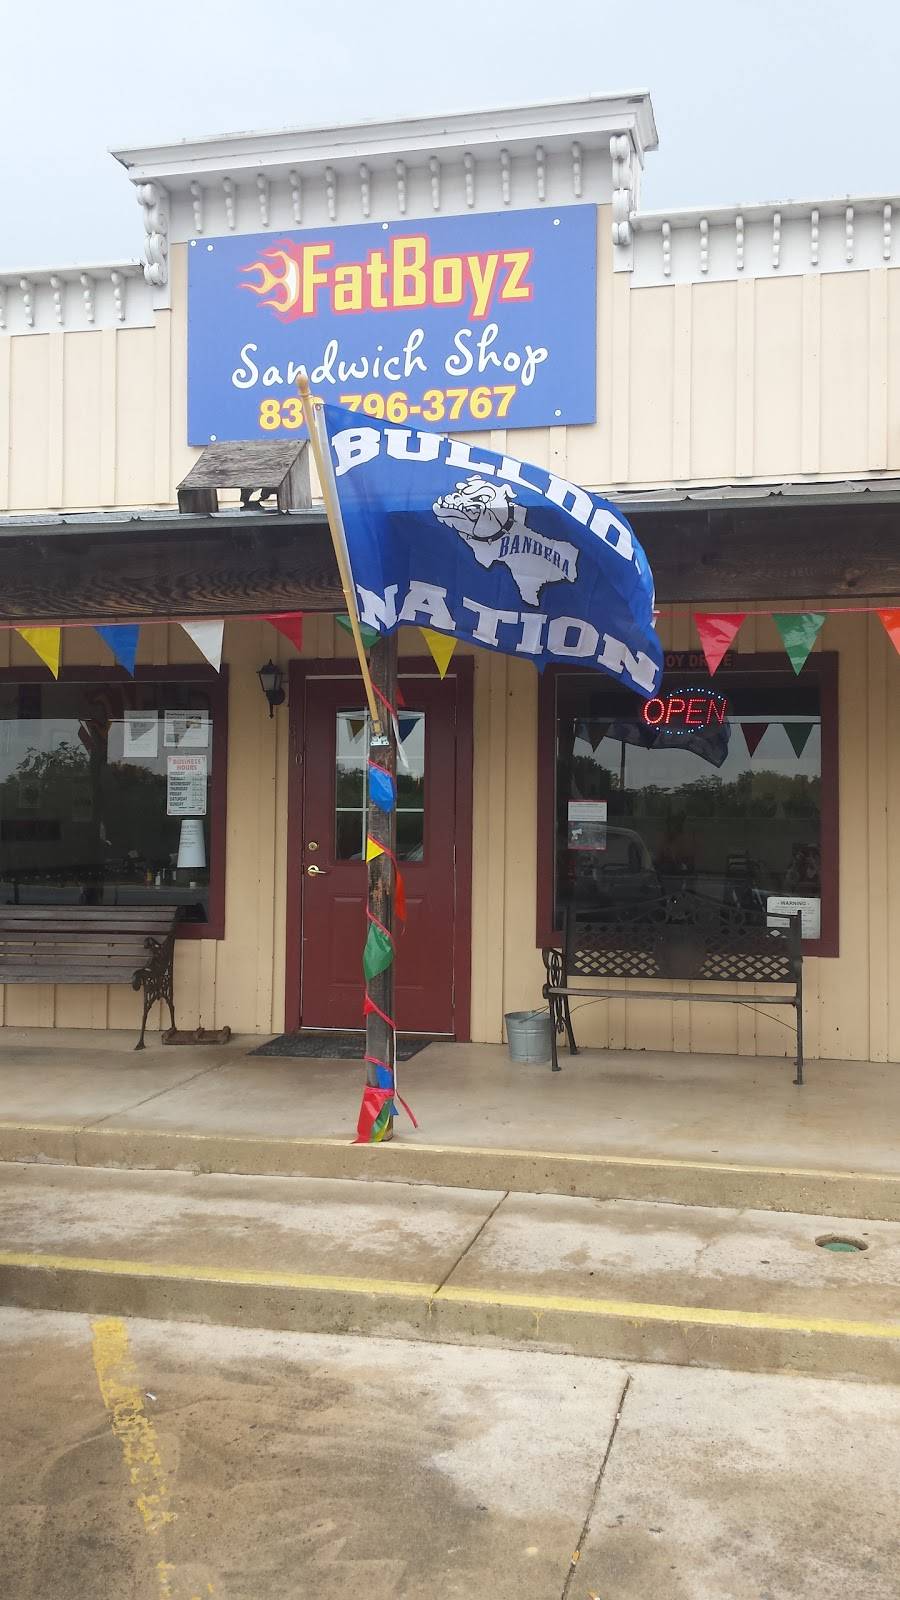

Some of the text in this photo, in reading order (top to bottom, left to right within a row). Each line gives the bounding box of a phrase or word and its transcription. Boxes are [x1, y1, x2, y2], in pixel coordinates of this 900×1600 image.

[301, 236, 531, 318] FatBoyz
[231, 323, 550, 390] Sandwich Shop
[331, 426, 643, 577] BULLDO
[498, 534, 570, 577] BANDERA
[355, 579, 660, 693] NATION
[689, 654, 732, 667] DRE
[642, 697, 728, 725] OPEN
